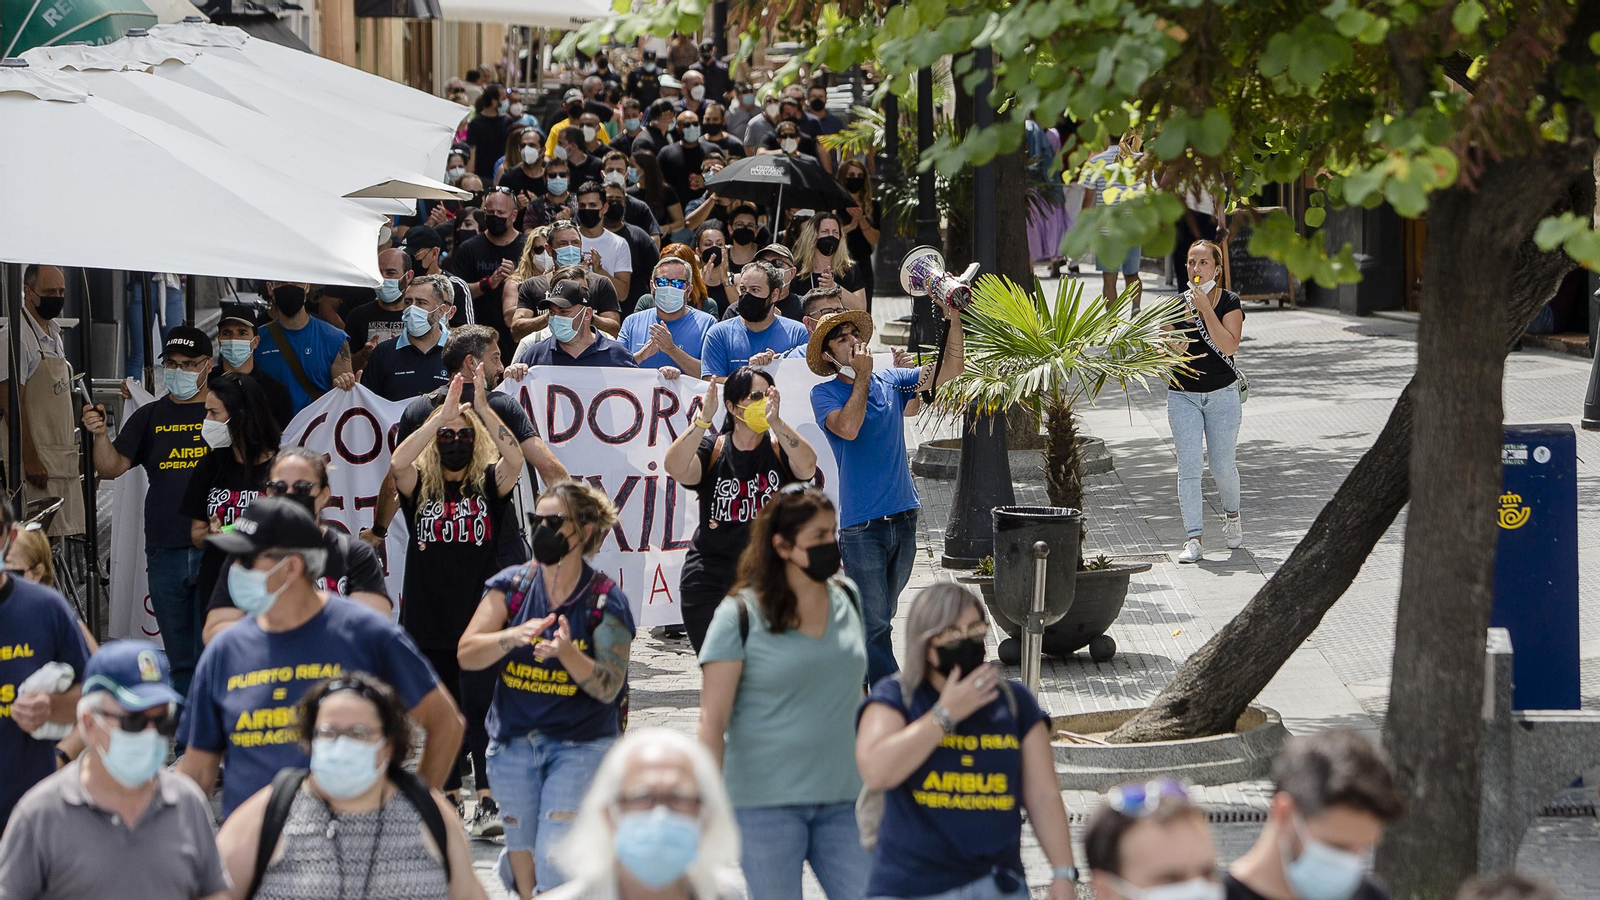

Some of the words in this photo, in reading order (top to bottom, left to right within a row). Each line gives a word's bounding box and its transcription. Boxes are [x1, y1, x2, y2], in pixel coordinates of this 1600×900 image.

[166, 338, 195, 347] AIRBUS
[155, 423, 203, 434] PUERTO
[0, 643, 34, 660] EAL
[227, 666, 294, 692] PUERTO
[506, 660, 569, 683] AIRBUS
[922, 771, 1008, 793] AIRBUS
